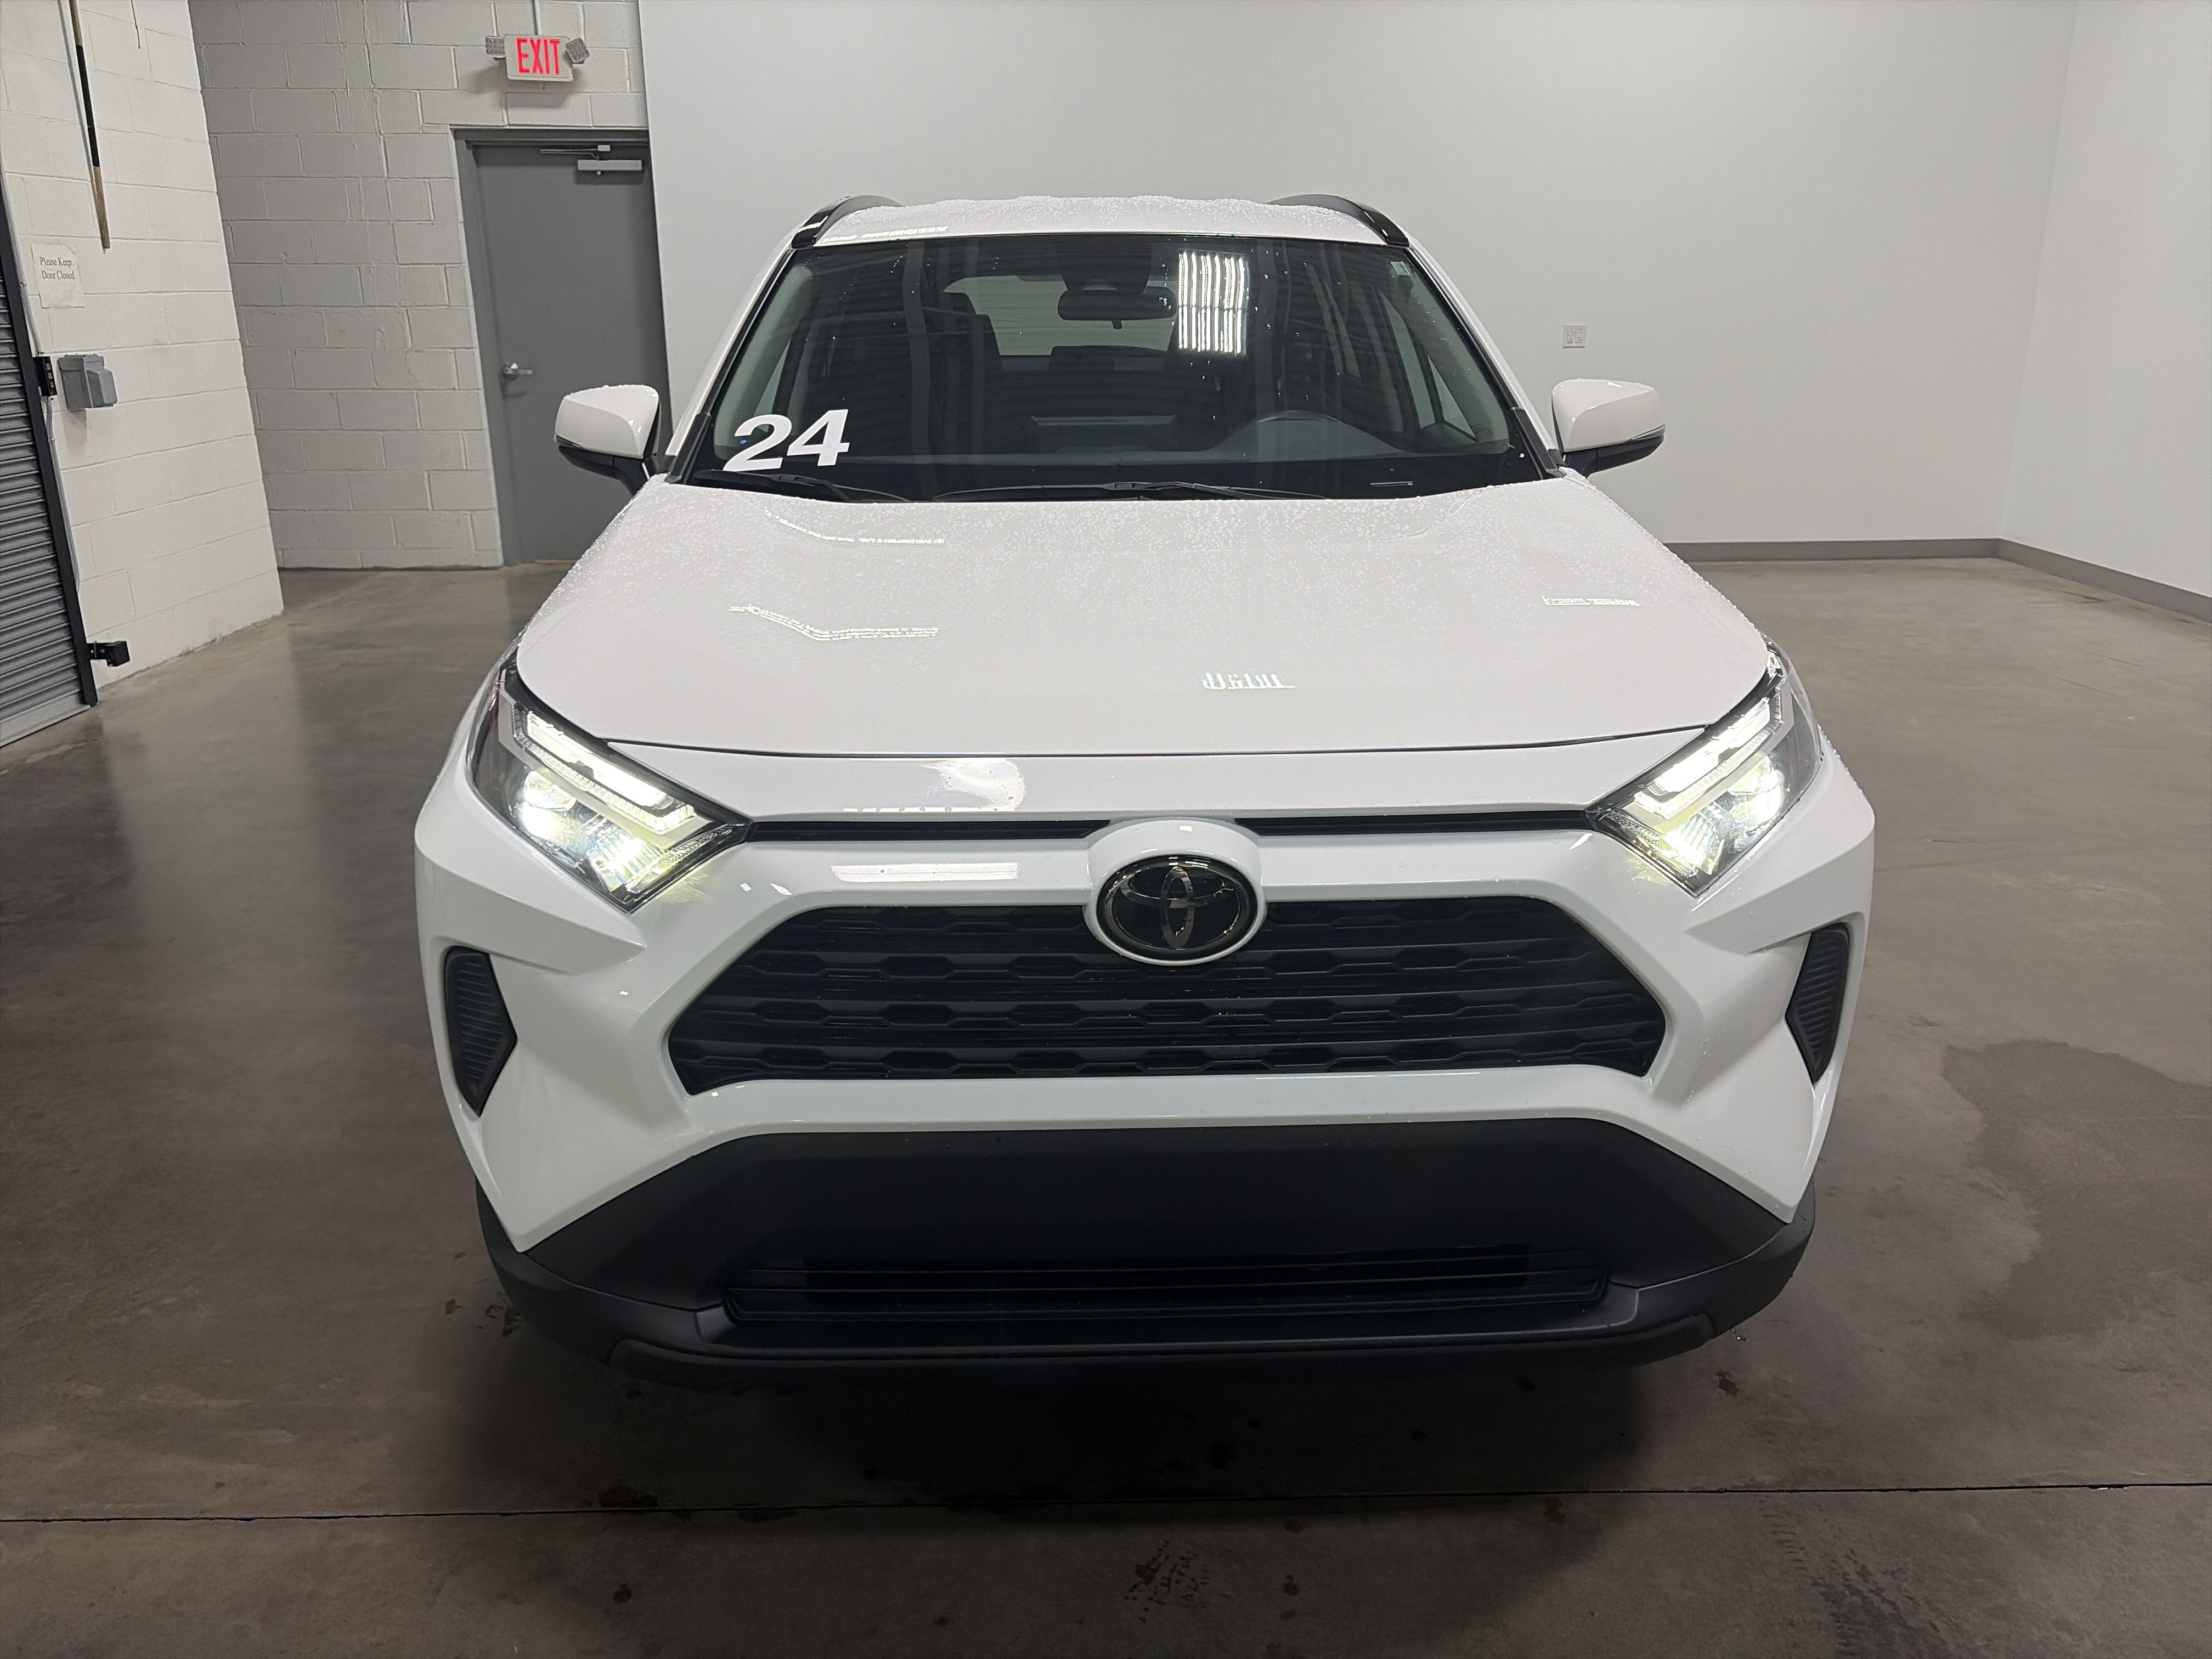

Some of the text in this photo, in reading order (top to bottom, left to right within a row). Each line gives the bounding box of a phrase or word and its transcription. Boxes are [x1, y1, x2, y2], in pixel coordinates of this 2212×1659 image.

[516, 37, 561, 75] EXIT
[40, 256, 72, 268] Please Keep
[42, 270, 75, 279] Door Closed
[723, 409, 850, 472] 24
